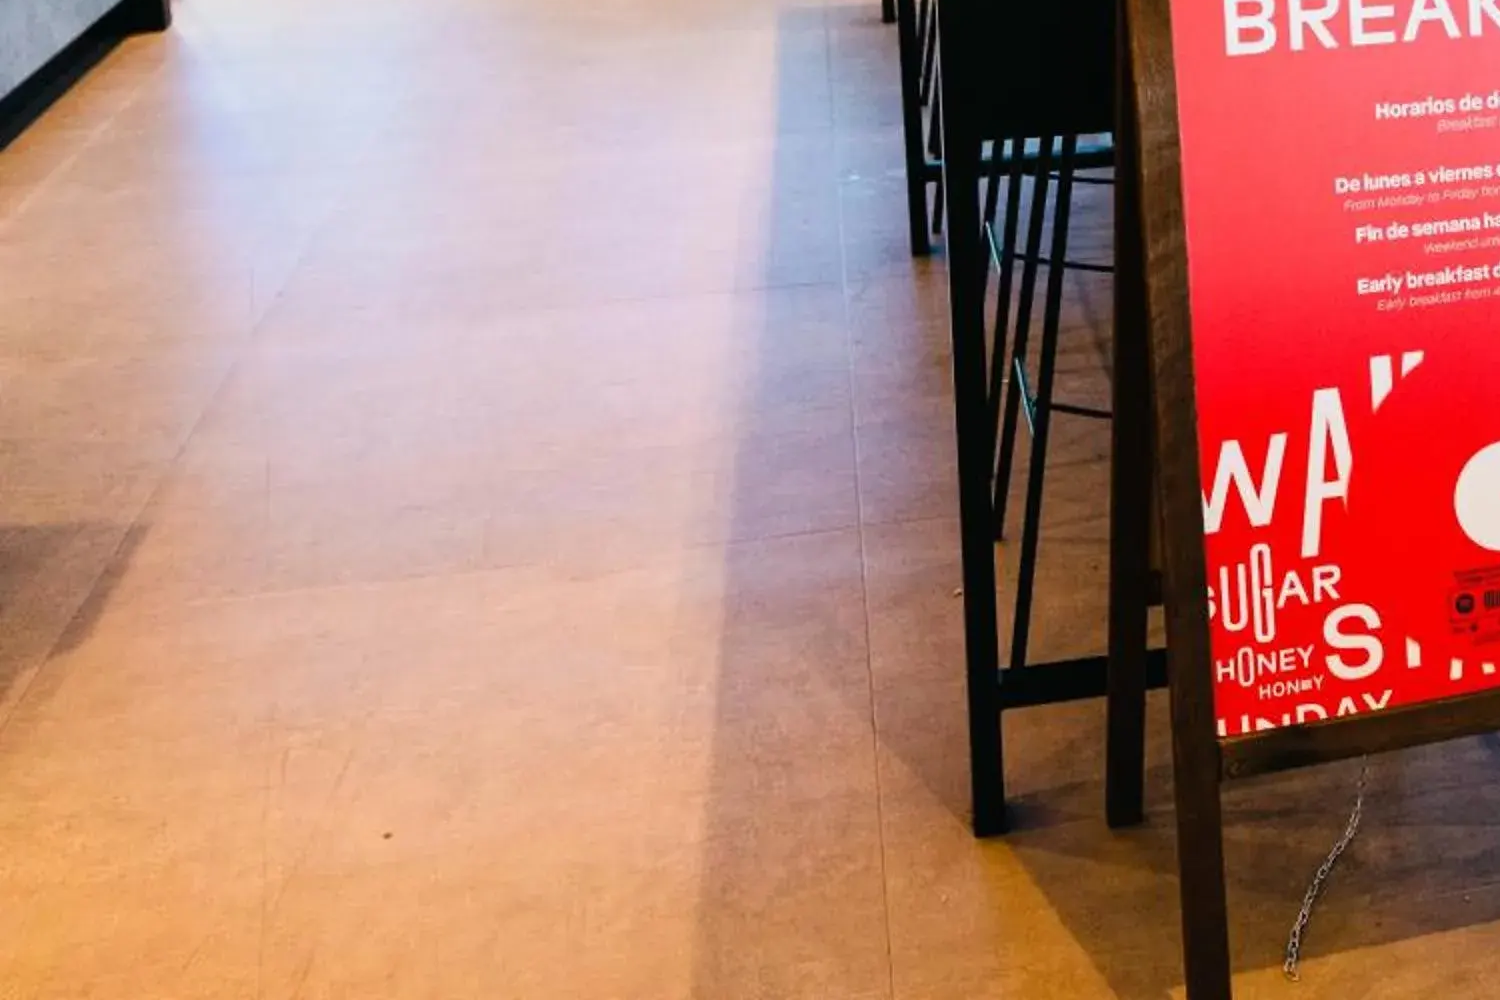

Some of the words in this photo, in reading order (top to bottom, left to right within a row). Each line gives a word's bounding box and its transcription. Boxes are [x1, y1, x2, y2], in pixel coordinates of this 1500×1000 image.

[1375, 96, 1455, 119] Horarios
[1459, 93, 1483, 111] de
[1334, 177, 1360, 194] De
[1363, 172, 1411, 191] lunes
[1414, 171, 1425, 185] a
[1428, 165, 1492, 183] viernes
[1355, 224, 1383, 243] Fin
[1386, 221, 1409, 240] de
[1411, 216, 1480, 236] semana
[1357, 273, 1402, 295] Early
[1406, 264, 1490, 289] breakfast
[1216, 644, 1314, 687] HONEY
[1259, 675, 1324, 700] HONEY
